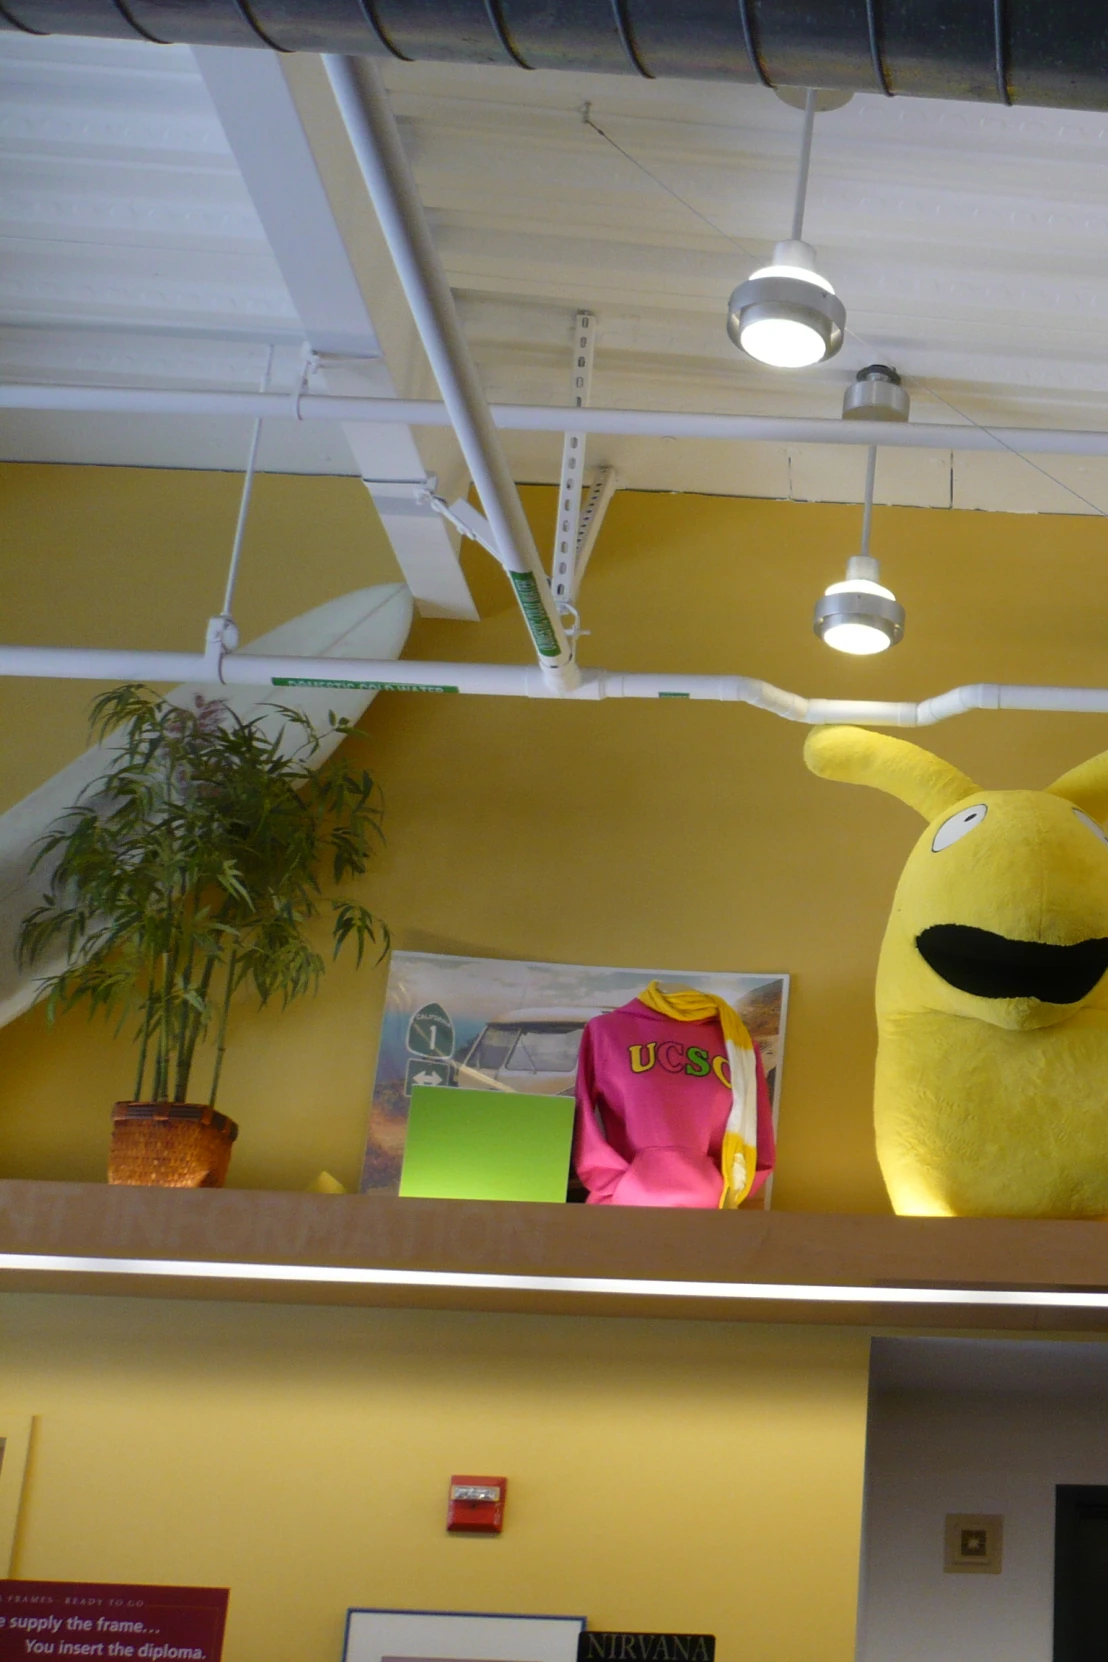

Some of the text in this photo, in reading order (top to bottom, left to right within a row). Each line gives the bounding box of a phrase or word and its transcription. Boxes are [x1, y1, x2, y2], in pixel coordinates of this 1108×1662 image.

[429, 1025, 437, 1050] 1
[103, 1186, 546, 1263] INFORMATION
[64, 1596, 104, 1606] READY
[108, 1598, 124, 1607] TO
[9, 1614, 63, 1633] supply
[66, 1616, 94, 1631] the
[96, 1617, 161, 1634] frame...
[25, 1639, 208, 1661] You insert the diploma.
[586, 1633, 710, 1661] NIRVANA
